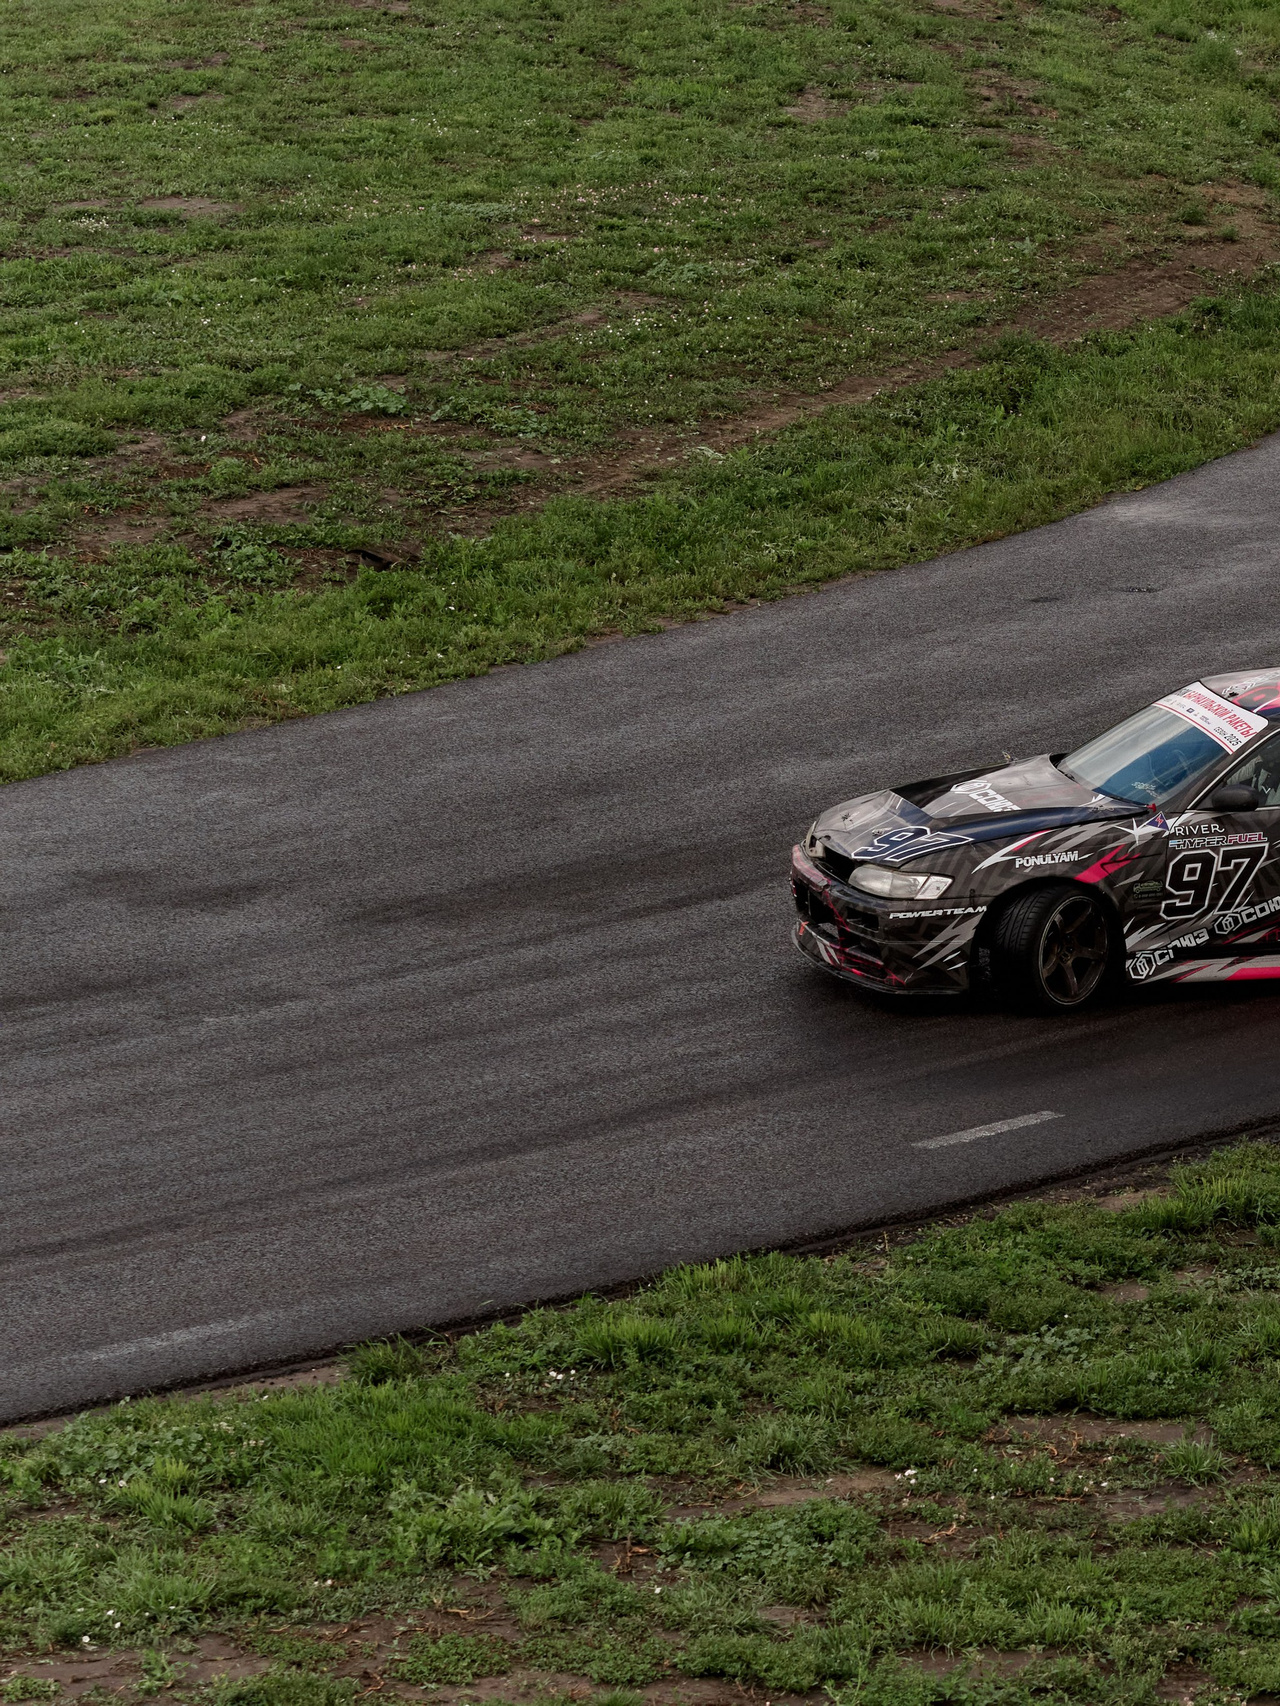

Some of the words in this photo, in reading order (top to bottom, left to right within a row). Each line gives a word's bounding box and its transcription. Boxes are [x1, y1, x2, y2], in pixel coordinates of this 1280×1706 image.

[1223, 713, 1258, 738] РАКЕТЫ
[1174, 824, 1225, 836] RIVER
[851, 826, 975, 862] 97
[1015, 851, 1079, 868] PONULYAM
[1160, 842, 1269, 920] 97
